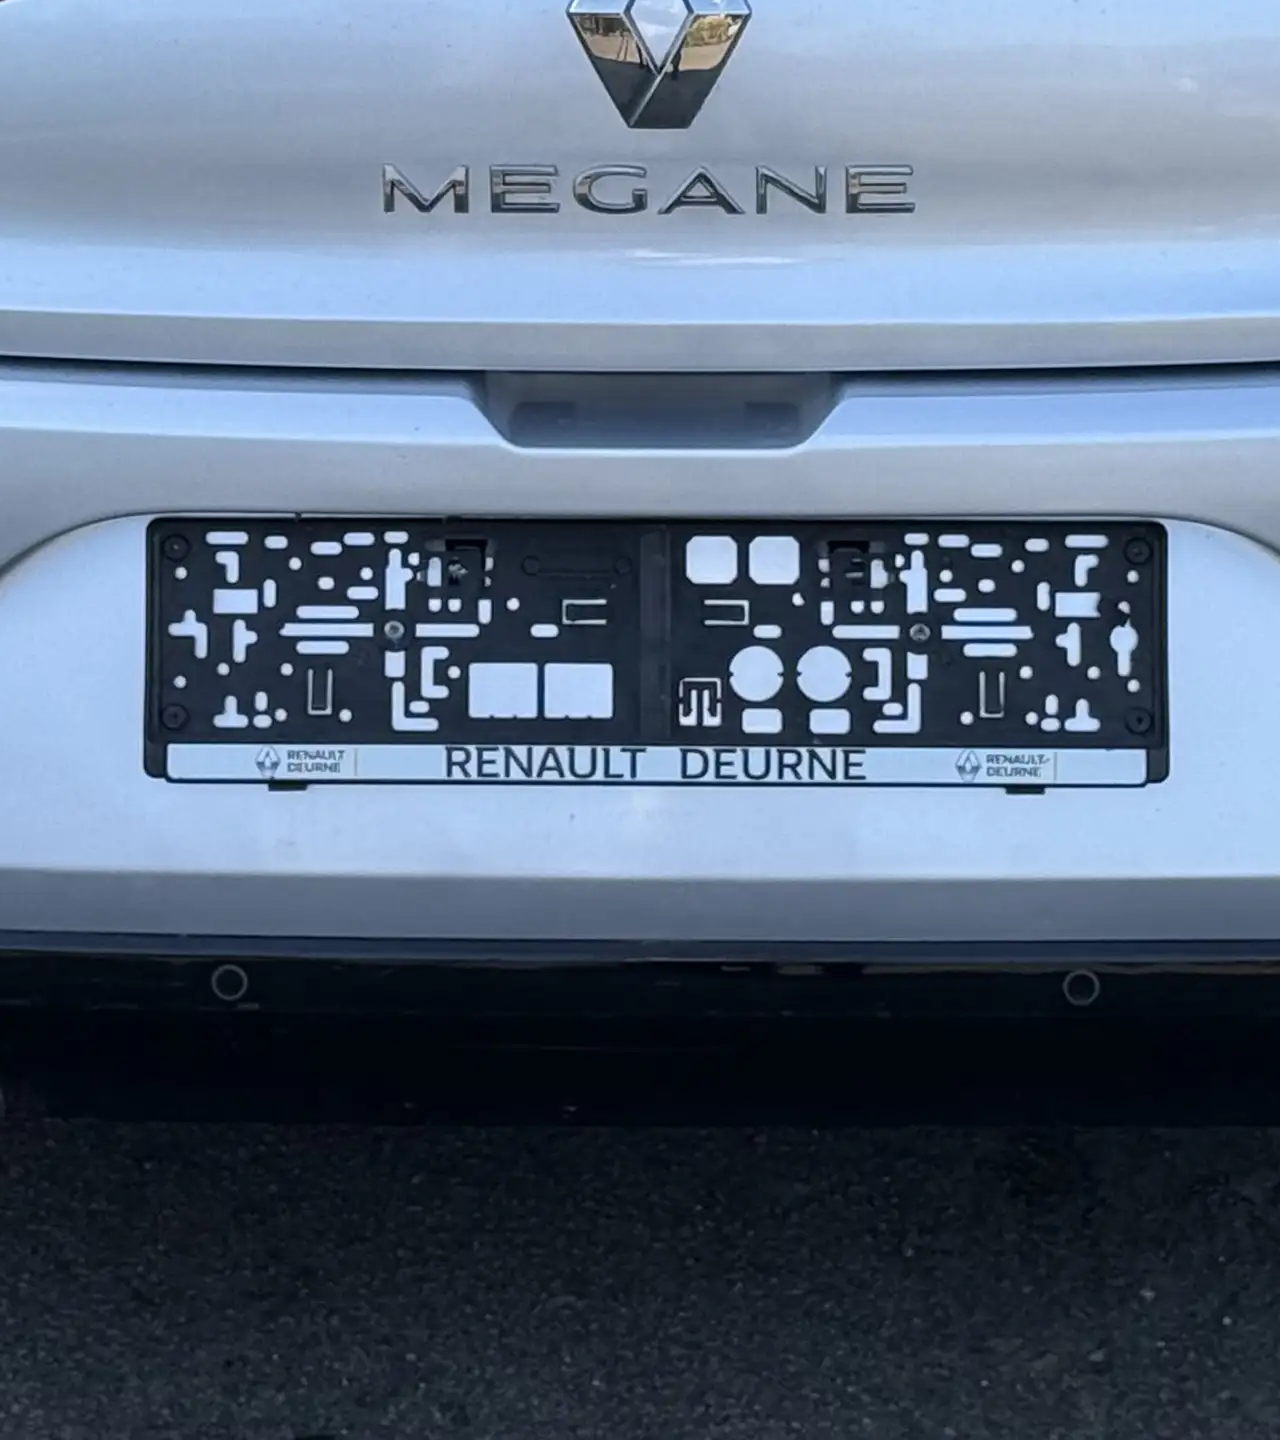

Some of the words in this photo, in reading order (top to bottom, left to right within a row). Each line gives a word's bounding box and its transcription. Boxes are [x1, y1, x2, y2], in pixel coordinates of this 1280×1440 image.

[382, 163, 916, 215] MEGANE
[445, 745, 647, 779] RENAULT
[679, 747, 868, 781] DEURNE
